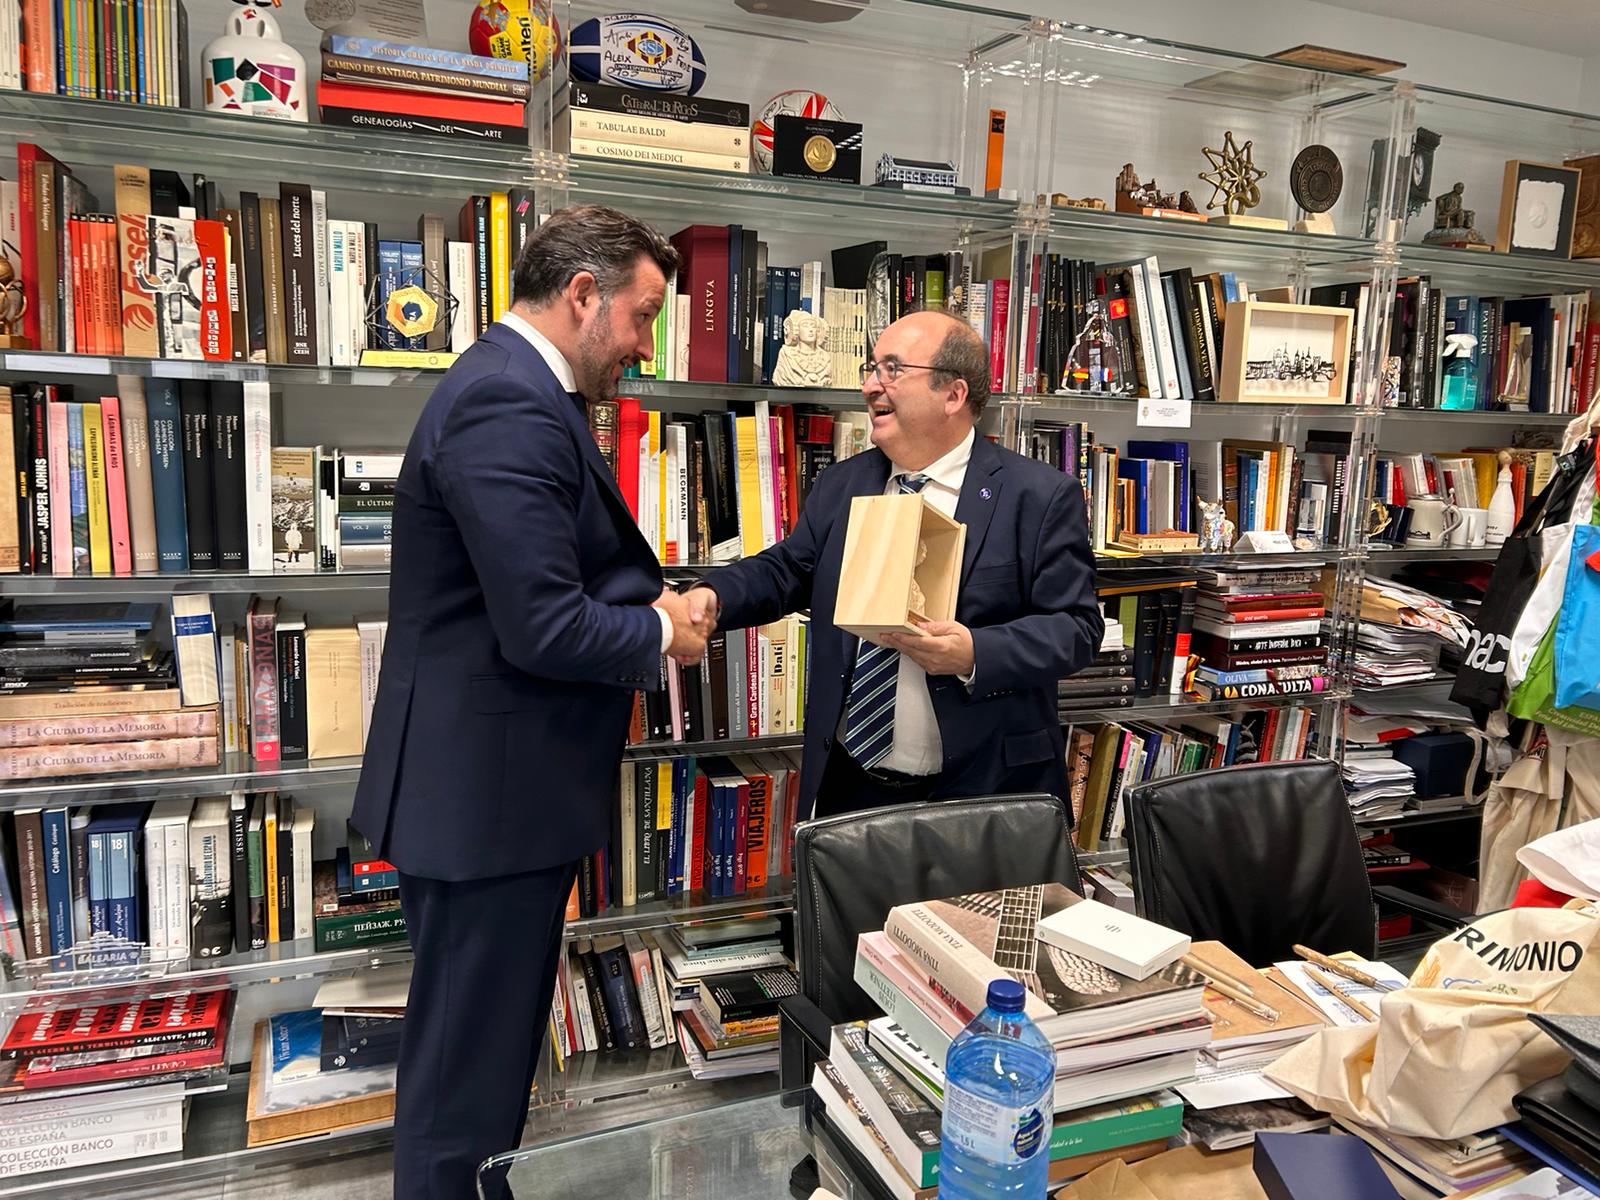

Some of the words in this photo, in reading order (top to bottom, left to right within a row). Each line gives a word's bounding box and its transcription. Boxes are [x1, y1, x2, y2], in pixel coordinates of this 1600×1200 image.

[327, 59, 361, 72] CAMINO
[363, 64, 376, 74] DE
[377, 66, 420, 81] SANTIAGO,
[420, 72, 471, 87] PATRIMONIO
[472, 79, 509, 92] MUNDIAL
[352, 115, 413, 130] GENEALOGÍAS
[440, 125, 454, 134] DEL
[484, 130, 502, 139] ARTE
[597, 121, 637, 135] TABULAE
[639, 125, 666, 137] BALDI
[597, 146, 632, 158] COSIMO
[634, 149, 650, 160] DEI
[651, 150, 683, 163] MEDICI
[292, 196, 300, 218] norte
[315, 202, 323, 221] JUAN
[292, 220, 301, 235] del
[292, 236, 302, 258] Luces
[315, 224, 325, 260] BAUTISTA
[334, 231, 343, 250] MALLO
[334, 251, 343, 272] MARUJA
[706, 280, 715, 332] LINGVA
[207, 310, 219, 355] ÚLTIMAS
[1193, 307, 1205, 349] HISPANIA
[1480, 310, 1489, 354] PATINIR
[107, 413, 117, 444] LÁGRIMAS
[35, 458, 48, 490] JOHNS
[37, 492, 49, 529] JASPER
[774, 645, 783, 673] Dalí
[750, 671, 758, 701] Cardenal
[1225, 673, 1248, 682] OLIVA
[750, 702, 758, 719] Gran
[27, 726, 41, 737] LA
[43, 725, 84, 736] CIUDAD
[87, 725, 99, 735] DE
[102, 725, 115, 733] LA
[117, 720, 166, 732] MEMORIA
[26, 757, 41, 767] LA
[43, 755, 84, 766] CIUDAD
[87, 755, 99, 764] DE
[102, 754, 115, 762] LA
[117, 749, 166, 761] MEMORIA
[644, 767, 652, 818] SANTILLANA
[644, 819, 650, 830] DE
[749, 779, 766, 851] VIAJEROS
[91, 839, 99, 848] 18
[112, 838, 123, 850] 18
[203, 835, 212, 853] ESPAÑA
[234, 815, 243, 854] MATISSE
[52, 846, 61, 874] Catálogo
[644, 855, 650, 864] EL
[354, 919, 392, 932] ПЕЙЗАЖ.
[911, 908, 946, 937] MODOTTI
[893, 925, 925, 959] MODOTTI
[947, 935, 963, 949] TINA
[922, 951, 940, 972] TINA
[868, 970, 896, 999] STETTNER
[879, 990, 896, 1014] LOUIS
[143, 1034, 185, 1043] ALICANTE,
[1, 1117, 68, 1137] COLECCIÓN
[71, 1114, 113, 1128] BANCO
[1, 1138, 17, 1148] DE
[19, 1131, 67, 1146] ESPAÑA
[0, 1145, 68, 1164] COLECCIÓN
[71, 1138, 113, 1154] BANCO
[0, 1164, 17, 1174] DE
[19, 1157, 67, 1172] ESPAÑA
